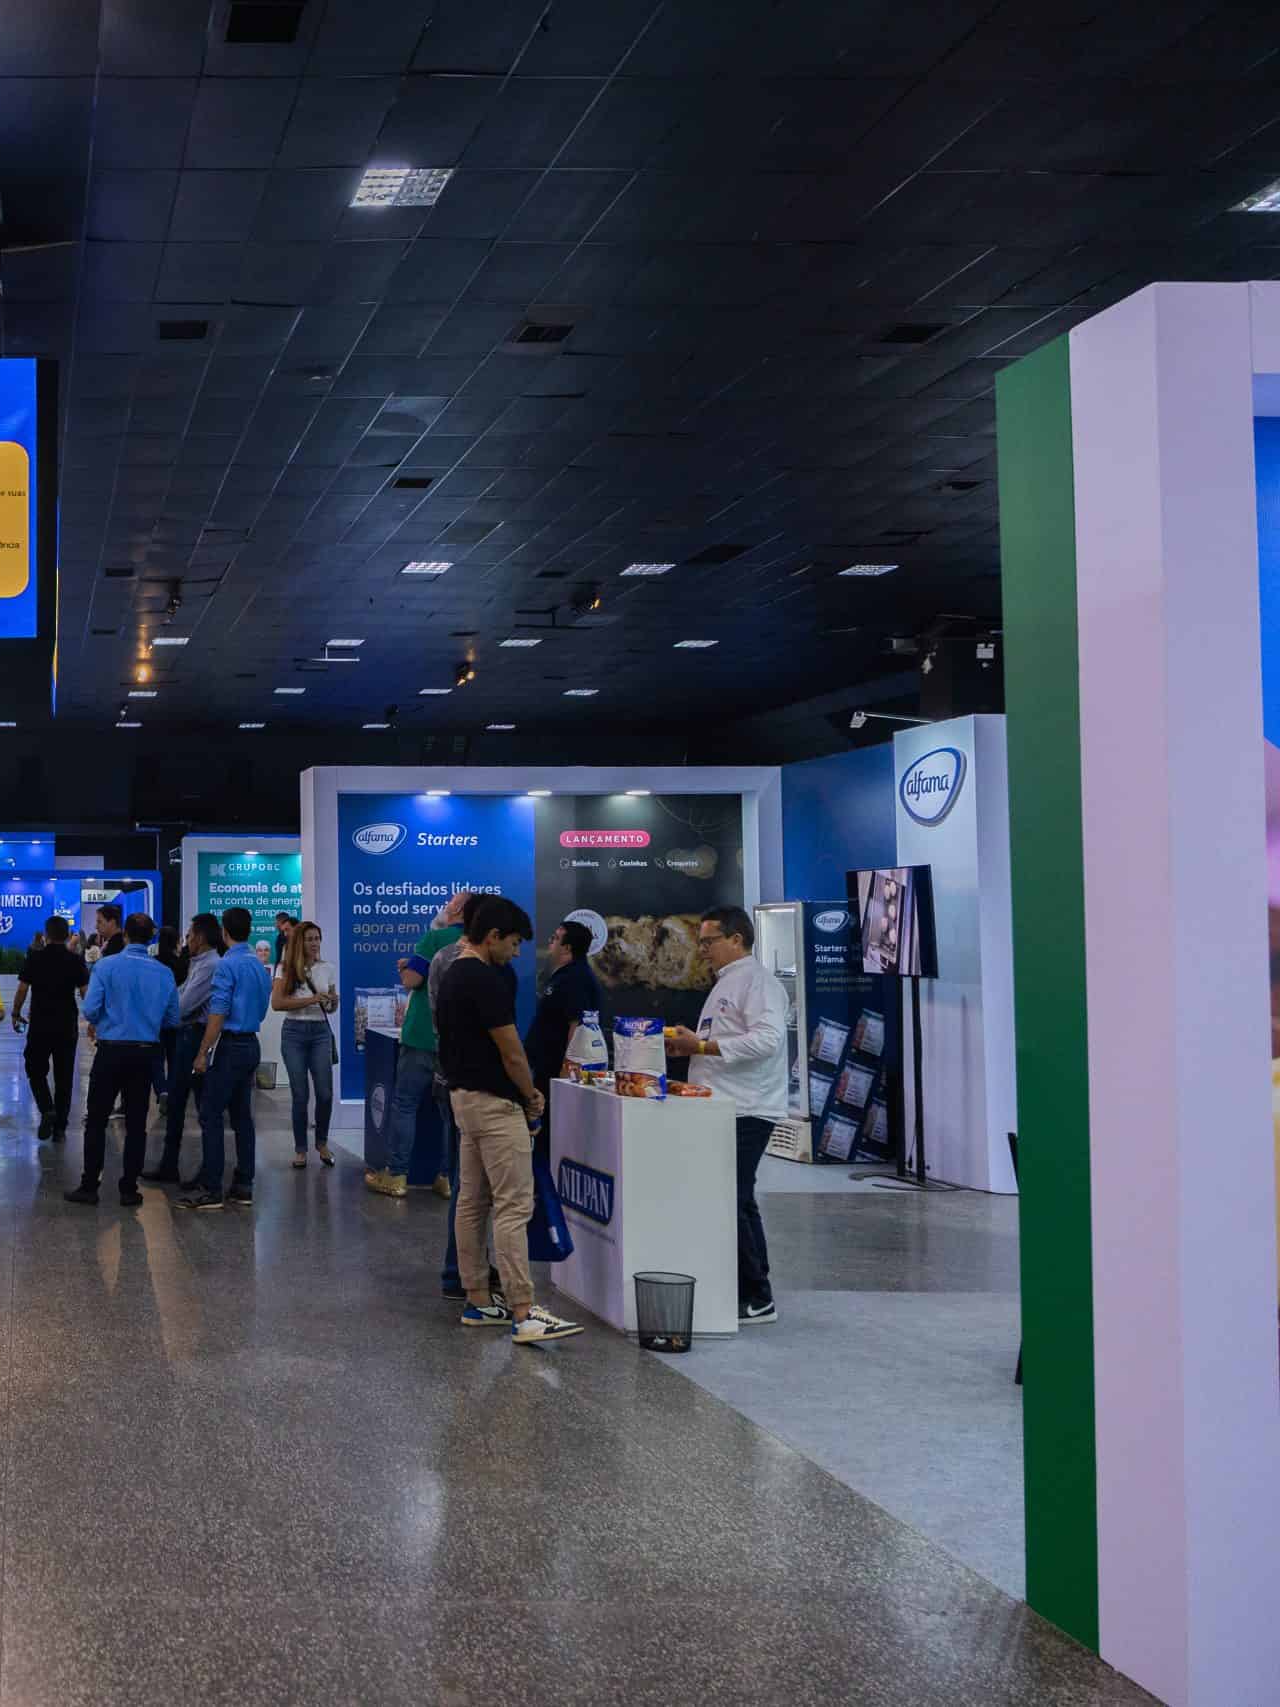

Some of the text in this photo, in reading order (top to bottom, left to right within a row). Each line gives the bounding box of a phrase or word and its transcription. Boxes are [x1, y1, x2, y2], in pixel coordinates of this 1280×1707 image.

[906, 770, 949, 801] alfama
[358, 831, 478, 846] alfama Starters
[566, 835, 644, 845] LANÇAMENTO
[209, 882, 303, 893] Economia de at
[353, 882, 373, 896] Os
[377, 881, 448, 896] desfiados
[210, 896, 303, 907] na conta de energi
[353, 901, 449, 914] no food servi
[352, 923, 419, 936] agora em
[353, 942, 388, 952] novo
[814, 944, 848, 953] Starters
[561, 1164, 609, 1220] NILPAN
